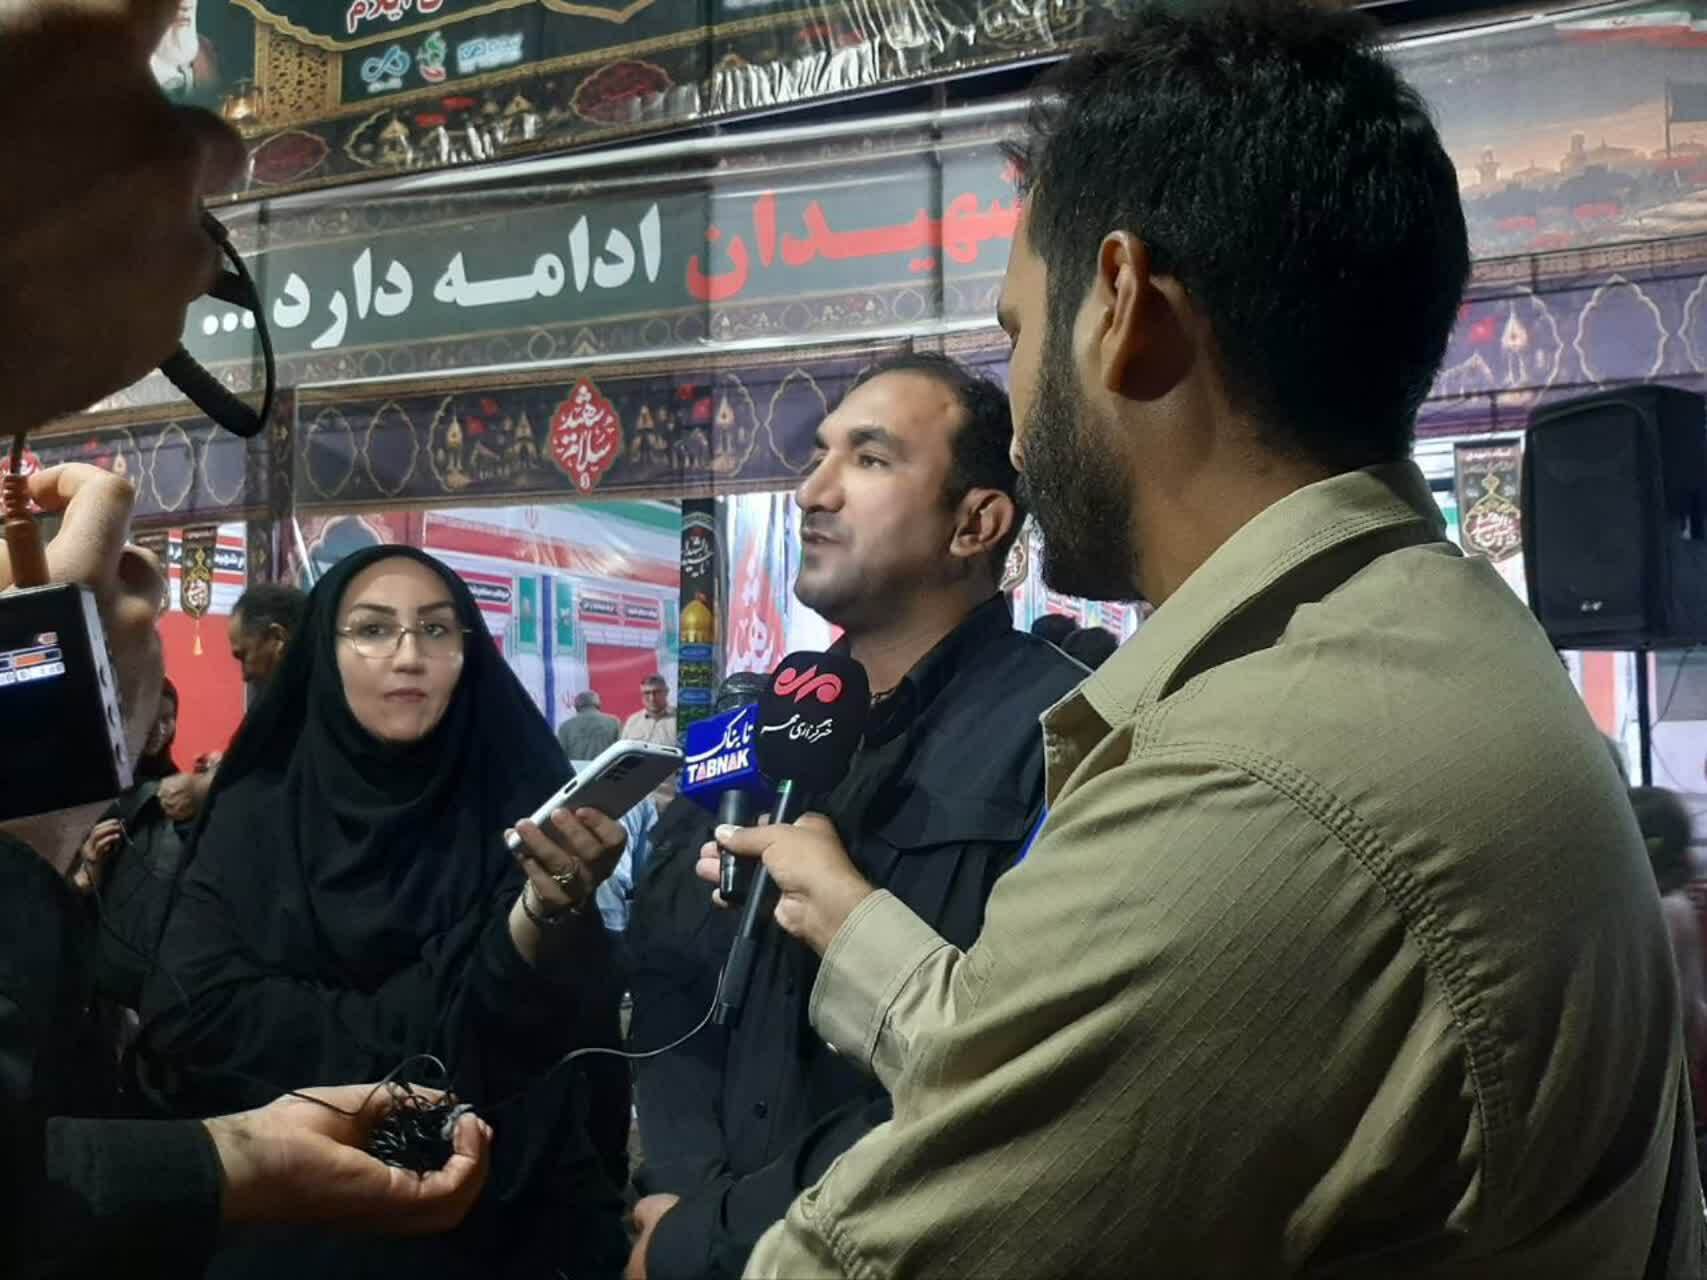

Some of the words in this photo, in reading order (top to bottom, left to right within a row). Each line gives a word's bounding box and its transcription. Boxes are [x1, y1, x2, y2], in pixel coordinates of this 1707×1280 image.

[433, 202, 662, 307] ادامه
[685, 708, 754, 763] تابناک
[789, 718, 833, 743] خبرگزاری
[687, 747, 750, 784] TABNAK
